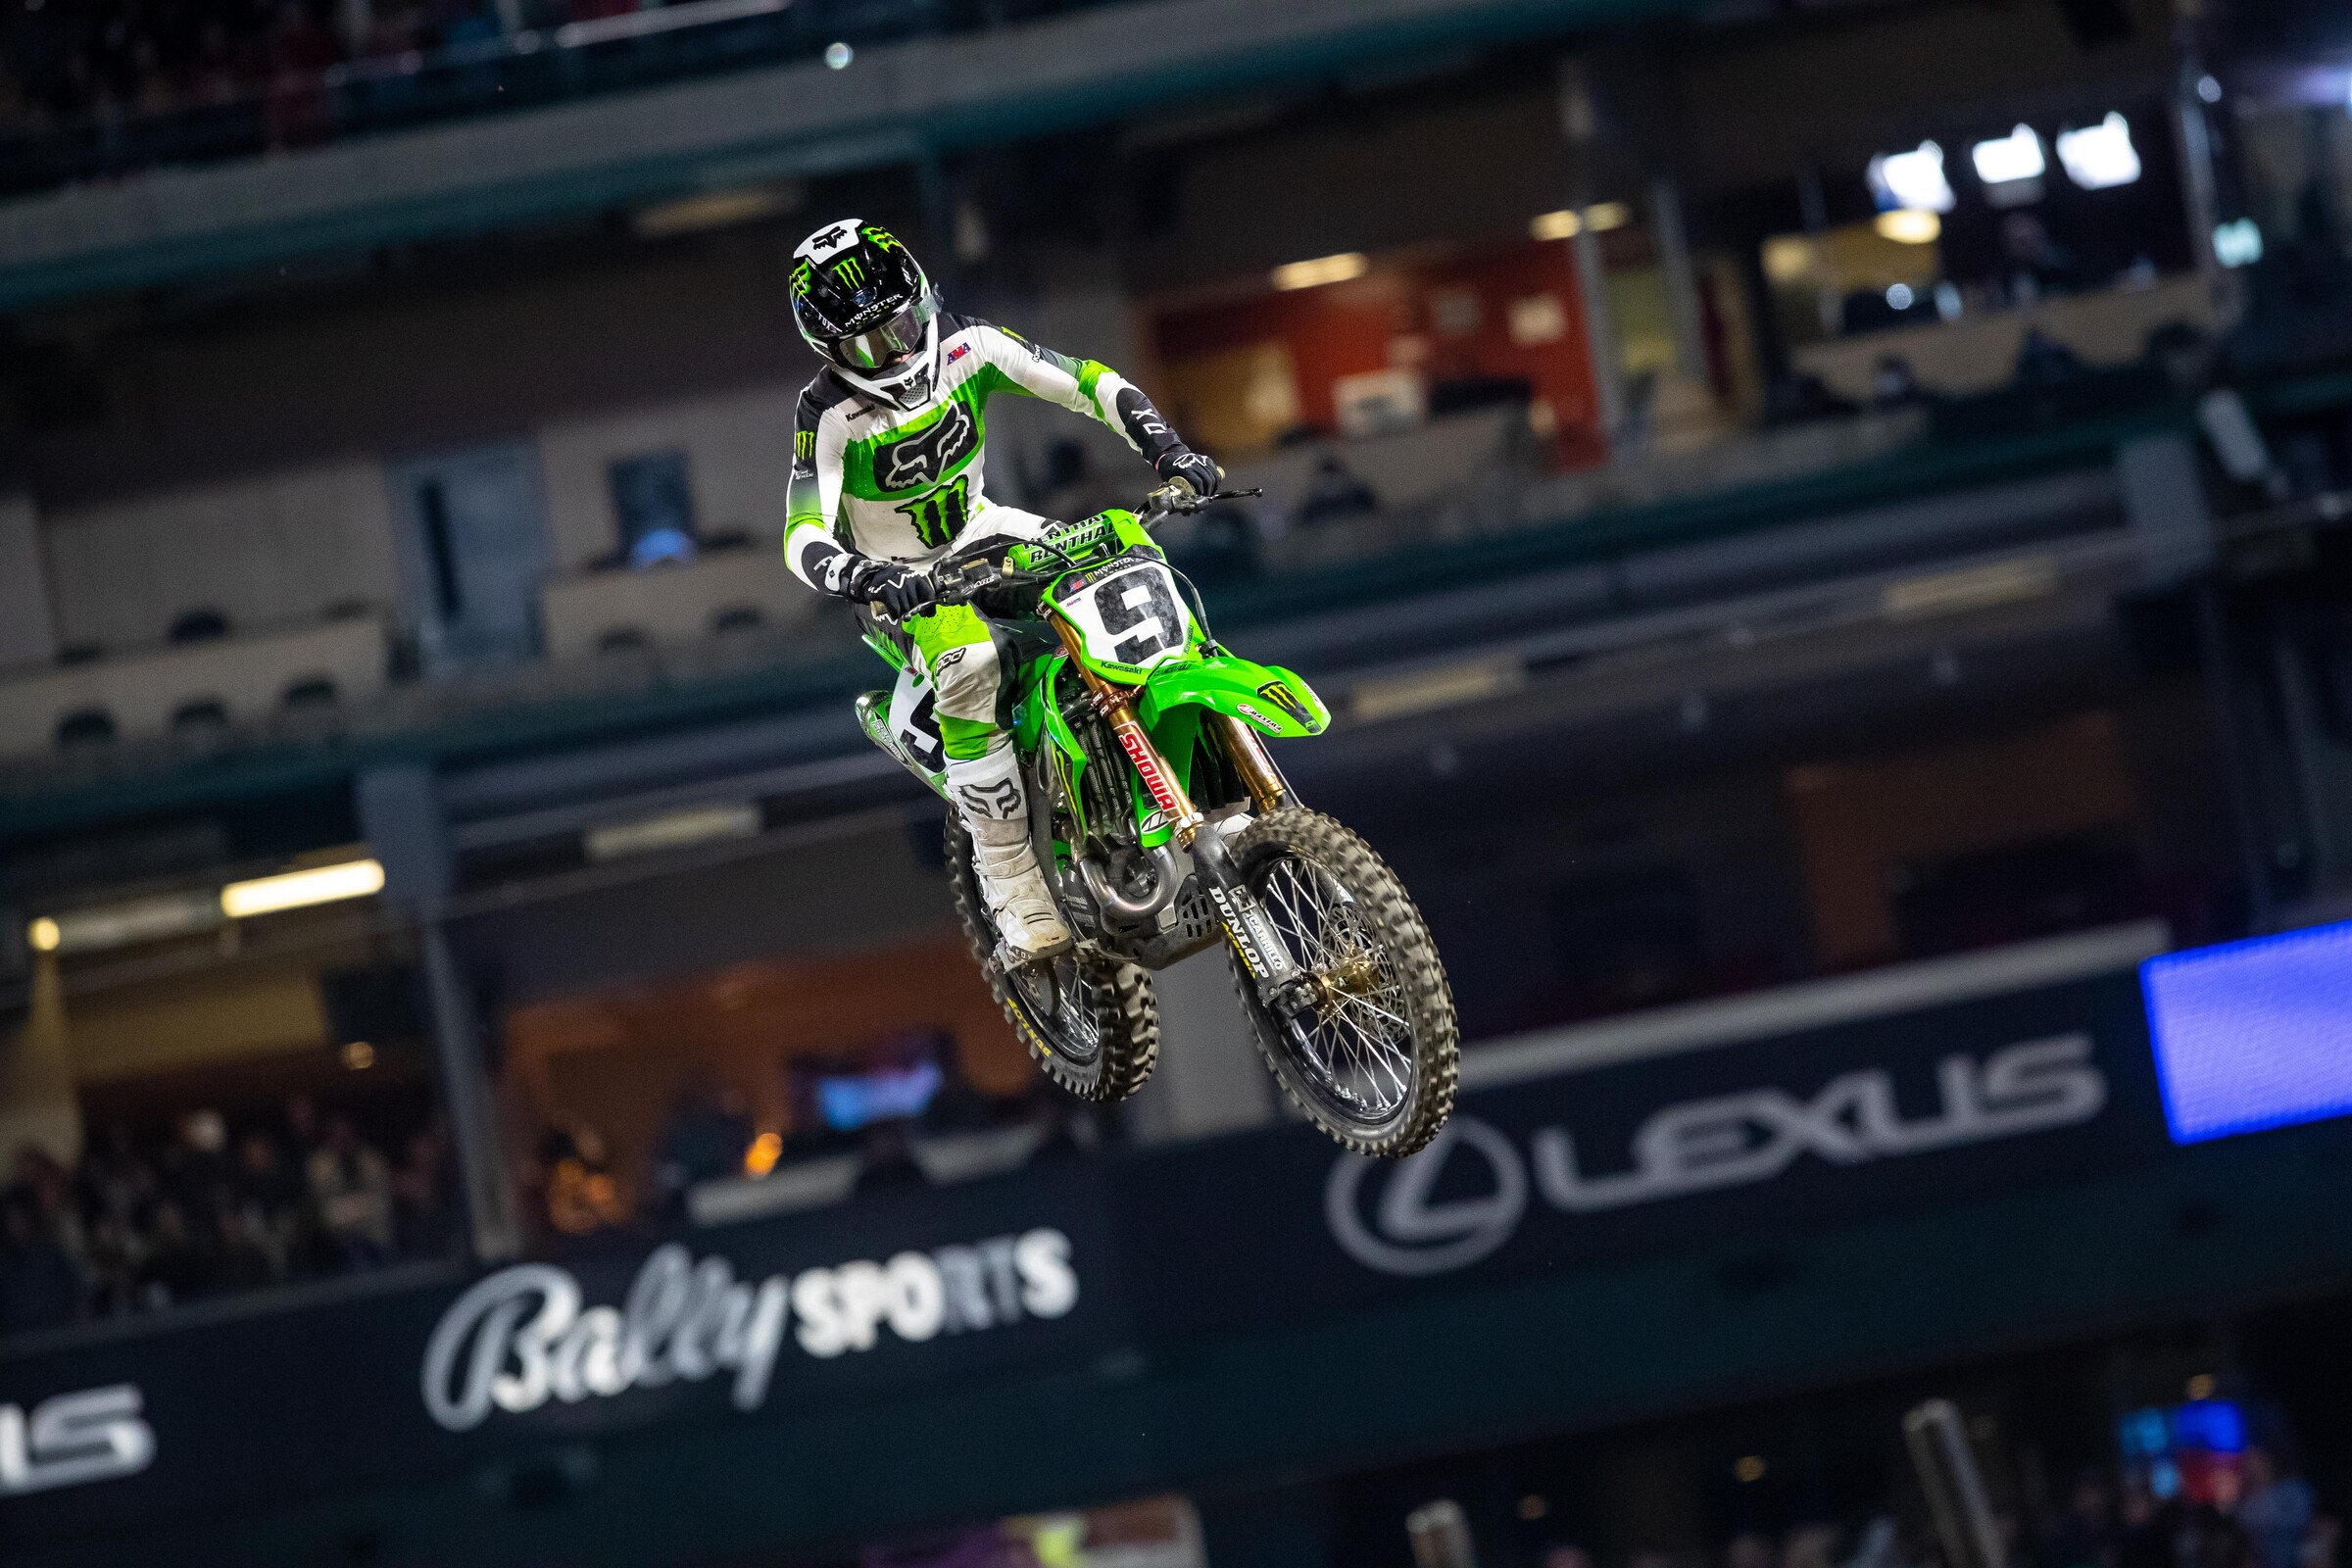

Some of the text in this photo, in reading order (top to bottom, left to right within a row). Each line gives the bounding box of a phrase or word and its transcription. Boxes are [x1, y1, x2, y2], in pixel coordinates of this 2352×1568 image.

[845, 293, 904, 328] MONSTER
[947, 342, 971, 366] AMA
[1094, 557, 1135, 577] MONSTER
[1094, 565, 1184, 665] 9
[1101, 661, 1143, 675] Kawasaki
[1118, 732, 1179, 812] SHOWA
[1208, 886, 1270, 979] DUNLOP
[1249, 914, 1284, 970] CARRILLO
[1534, 1033, 2108, 1212] LEXUS
[421, 1227, 1078, 1433] Bally SPORTS
